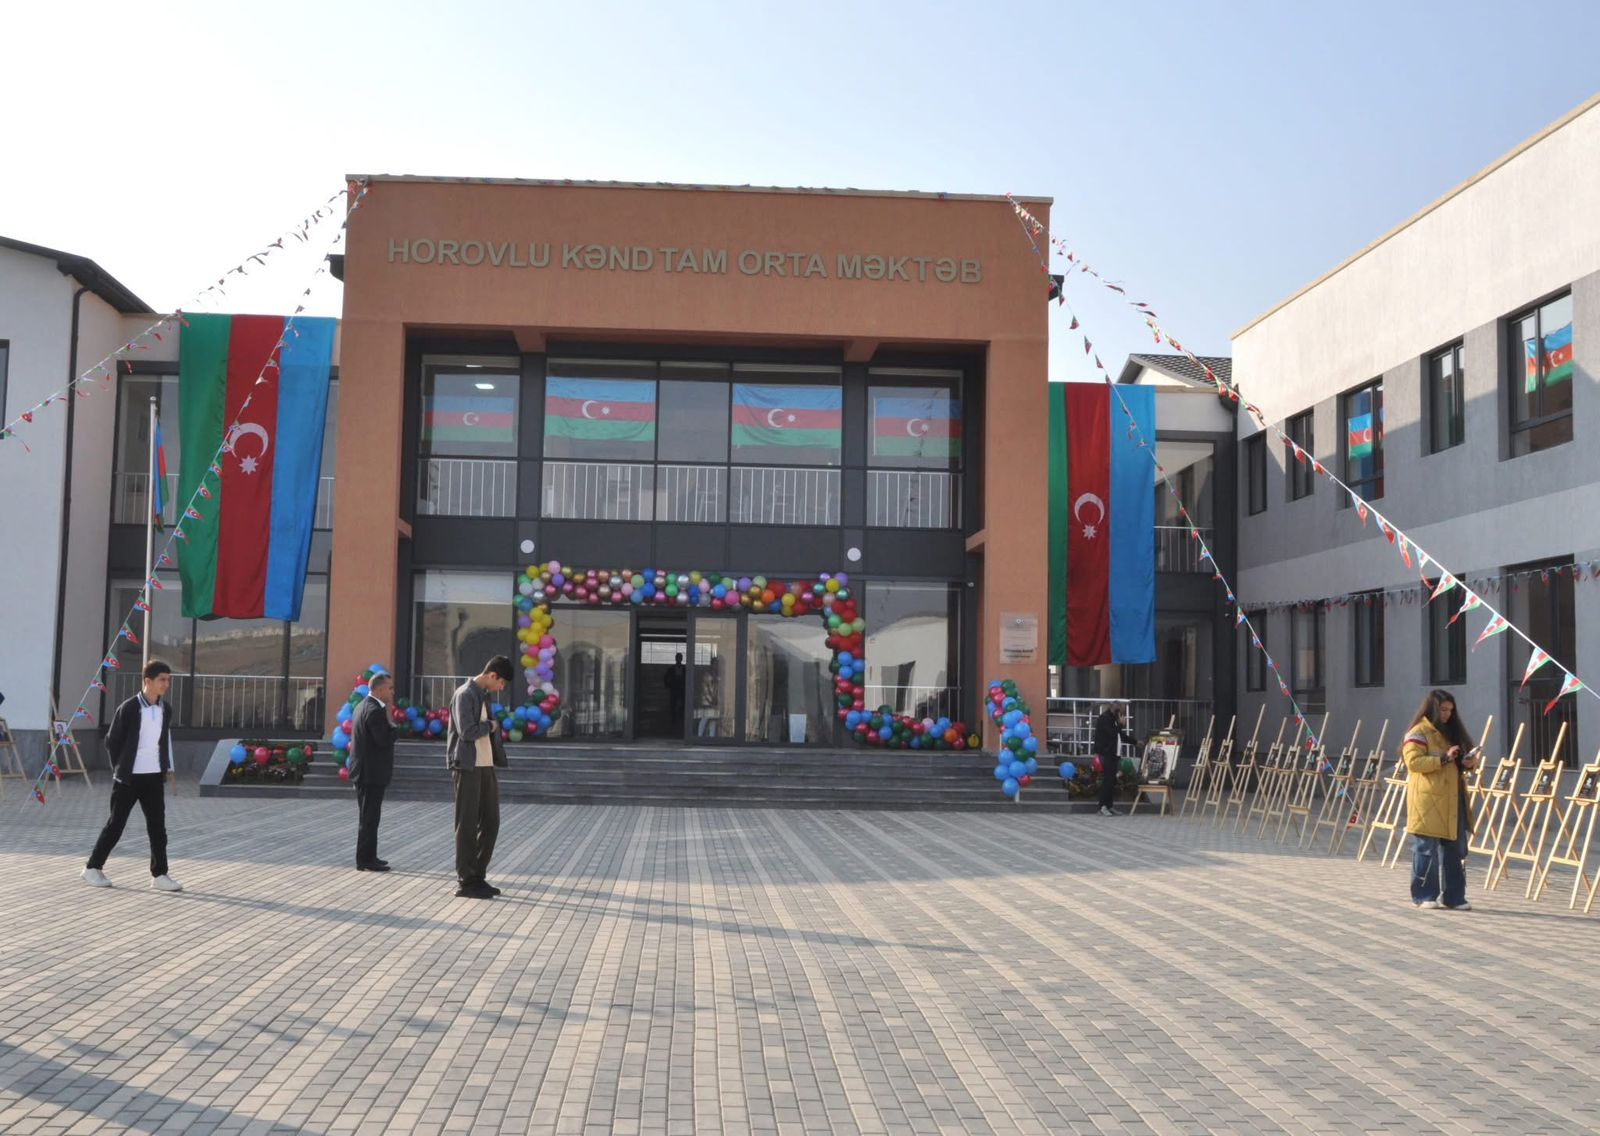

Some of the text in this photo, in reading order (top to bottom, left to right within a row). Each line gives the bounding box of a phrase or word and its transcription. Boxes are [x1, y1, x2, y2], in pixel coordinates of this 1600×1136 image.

[387, 238, 982, 283] HOROVLU KƏND TAM ORTA MƏKTƏB
